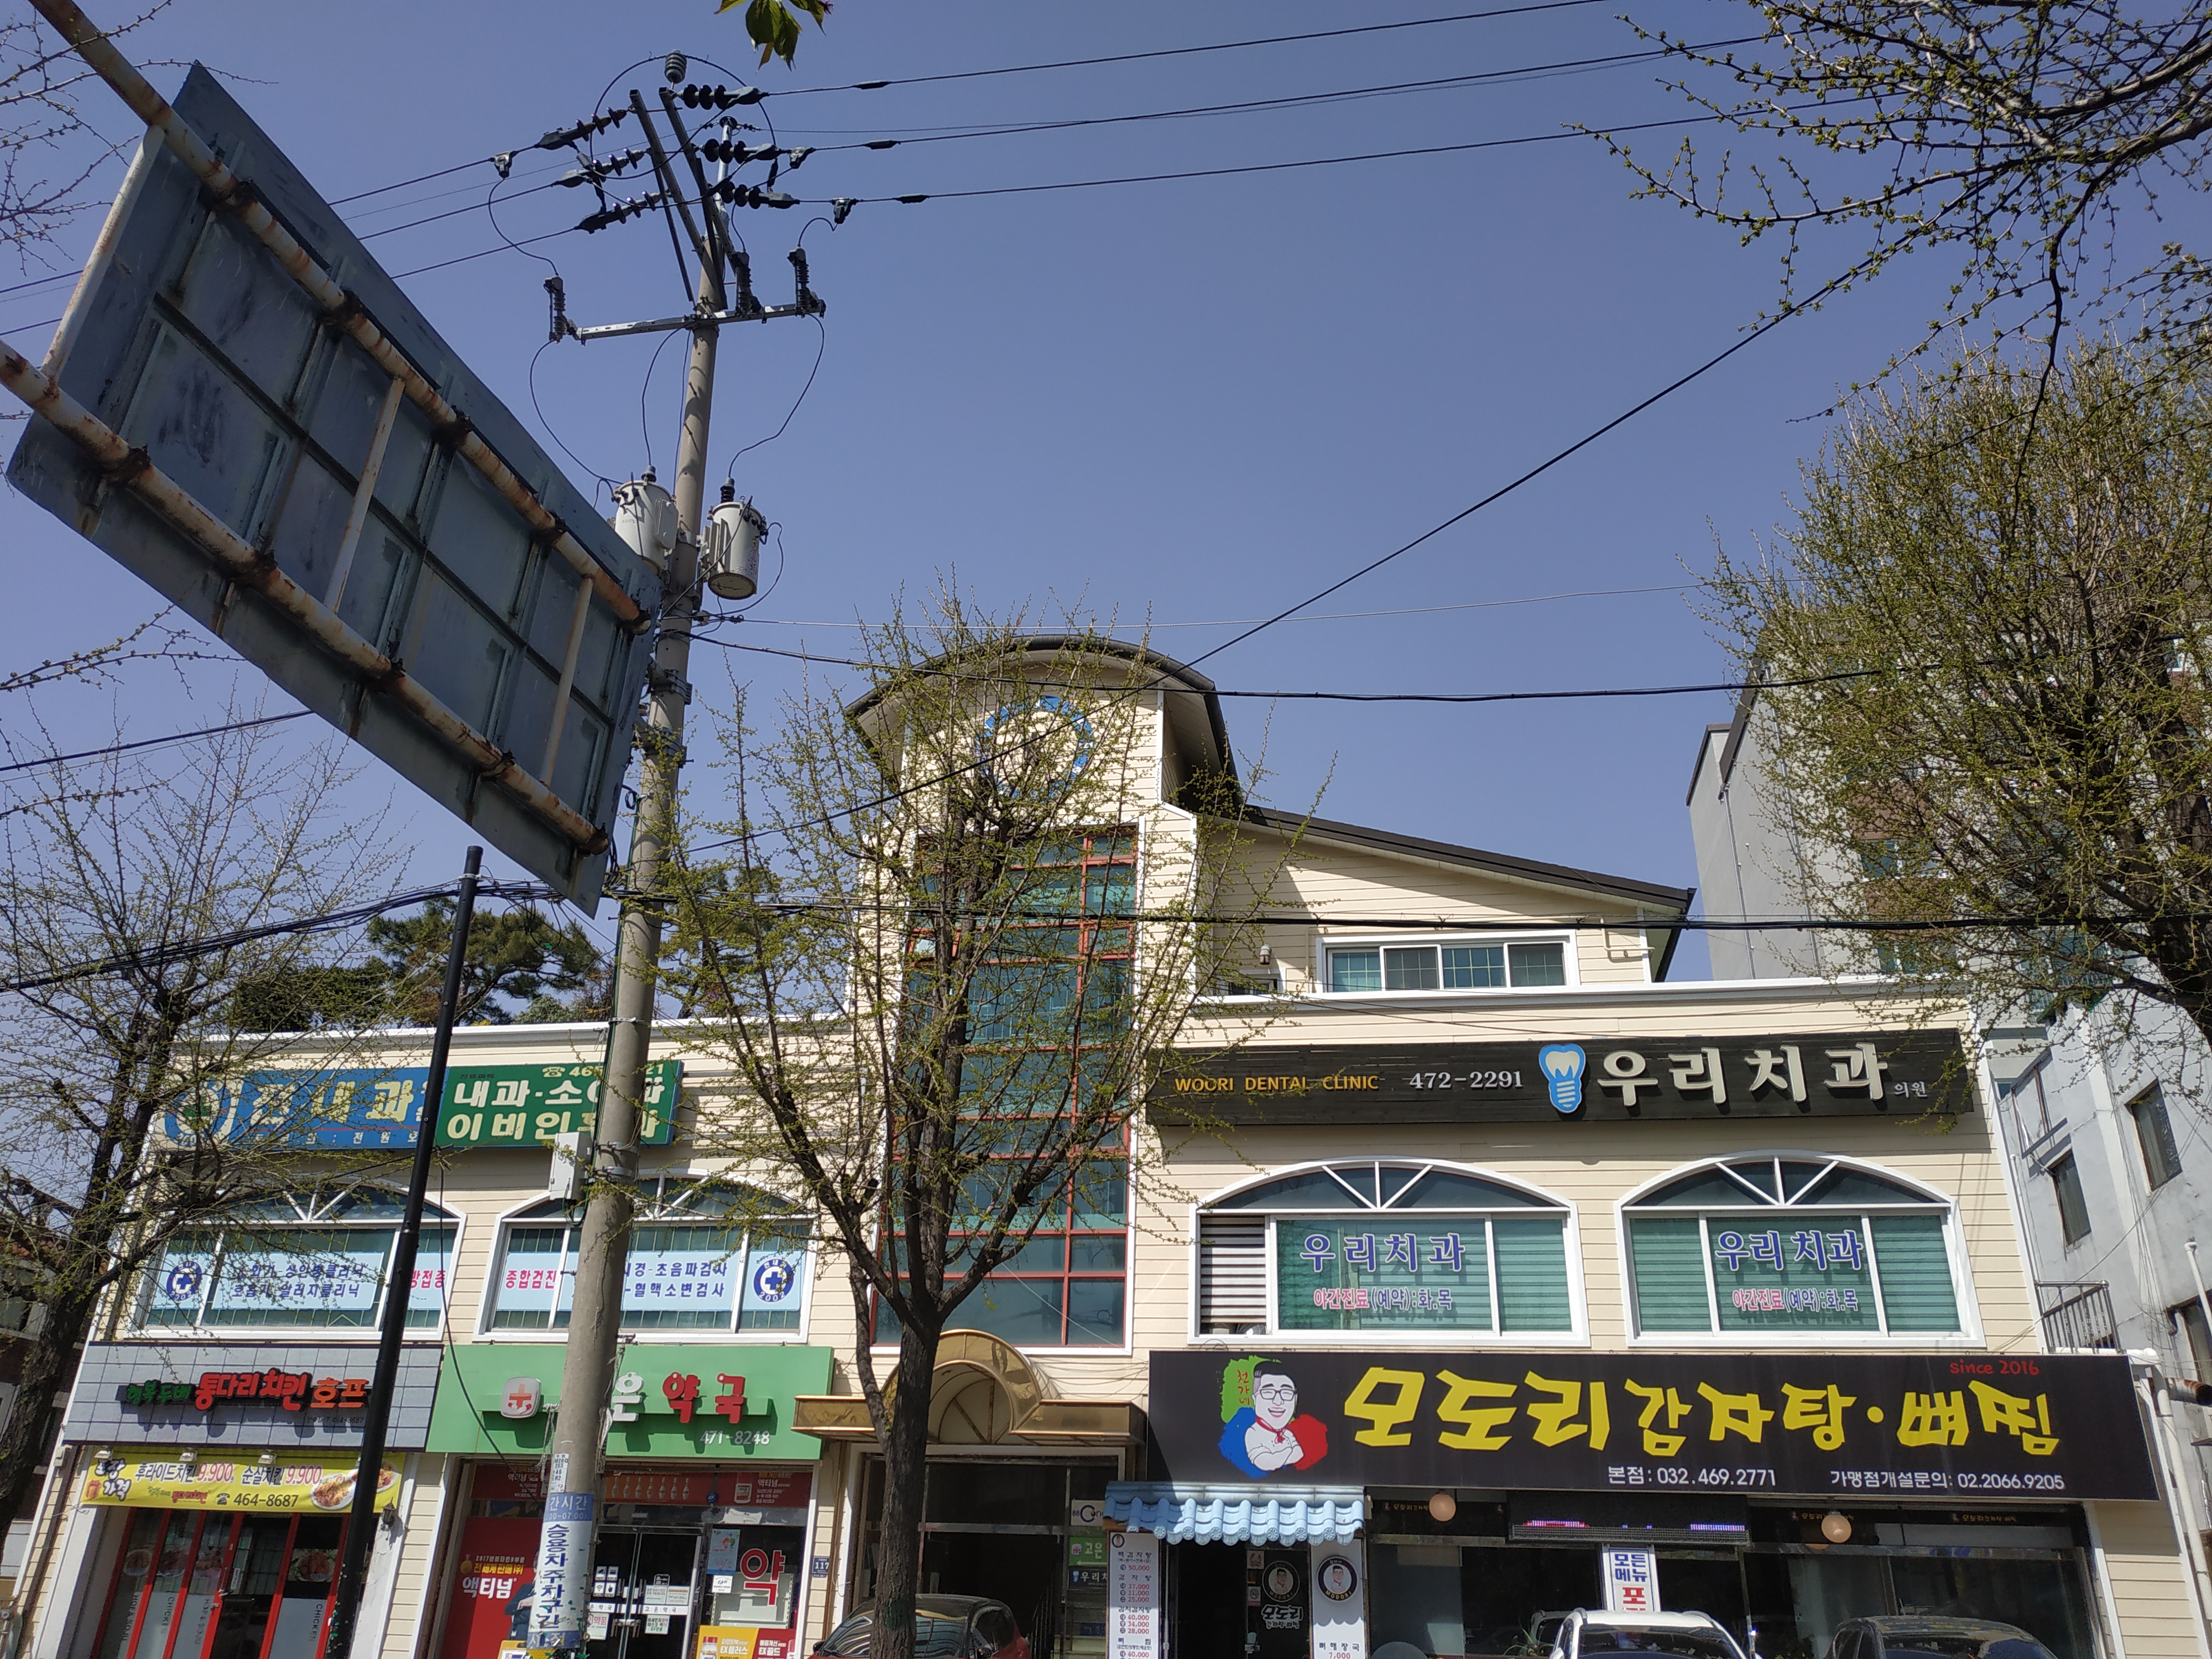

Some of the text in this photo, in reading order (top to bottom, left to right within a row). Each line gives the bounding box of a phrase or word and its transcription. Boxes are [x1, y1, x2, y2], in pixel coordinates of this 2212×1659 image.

[1175, 1071, 1523, 1092] WOORI DENTAL CLINIC 472-2291
[1597, 1043, 1928, 1107] 우리치과 의원
[1300, 1233, 1465, 1272] 우리치과
[1715, 1229, 1864, 1271] 우리치과
[505, 1270, 556, 1290] 종합검진
[759, 1291, 786, 1302] 2002
[1949, 1359, 2040, 1376] since 2016
[310, 1377, 369, 1408] 호프
[1237, 1369, 1250, 1406] 천가네
[700, 1430, 770, 1446] 471-8248
[135, 1463, 197, 1483] 후라이드치킨
[242, 1465, 285, 1486] 순살치킨
[758, 1479, 779, 1488] 액티넘
[1657, 1468, 1776, 1487] 032.469.2771
[1830, 1470, 2065, 1490] 가맹점개설문의: 02.2066.9205
[233, 1493, 299, 1507] 464-8687
[547, 1496, 587, 1511] 간시간
[1084, 1541, 1103, 1559] 고은
[815, 1562, 830, 1570] 117
[1614, 1553, 1646, 1568] 모든
[740, 1548, 786, 1606] 약
[1614, 1568, 1648, 1582] 메뉴
[462, 1577, 514, 1599] 액티넘
[1326, 1589, 1353, 1600] MODORI
[1622, 1587, 1647, 1611] 포
[1261, 1604, 1304, 1621] 모도리
[309, 1604, 323, 1642] CHICKEN
[1319, 1642, 1360, 1652] 뼈해장국
